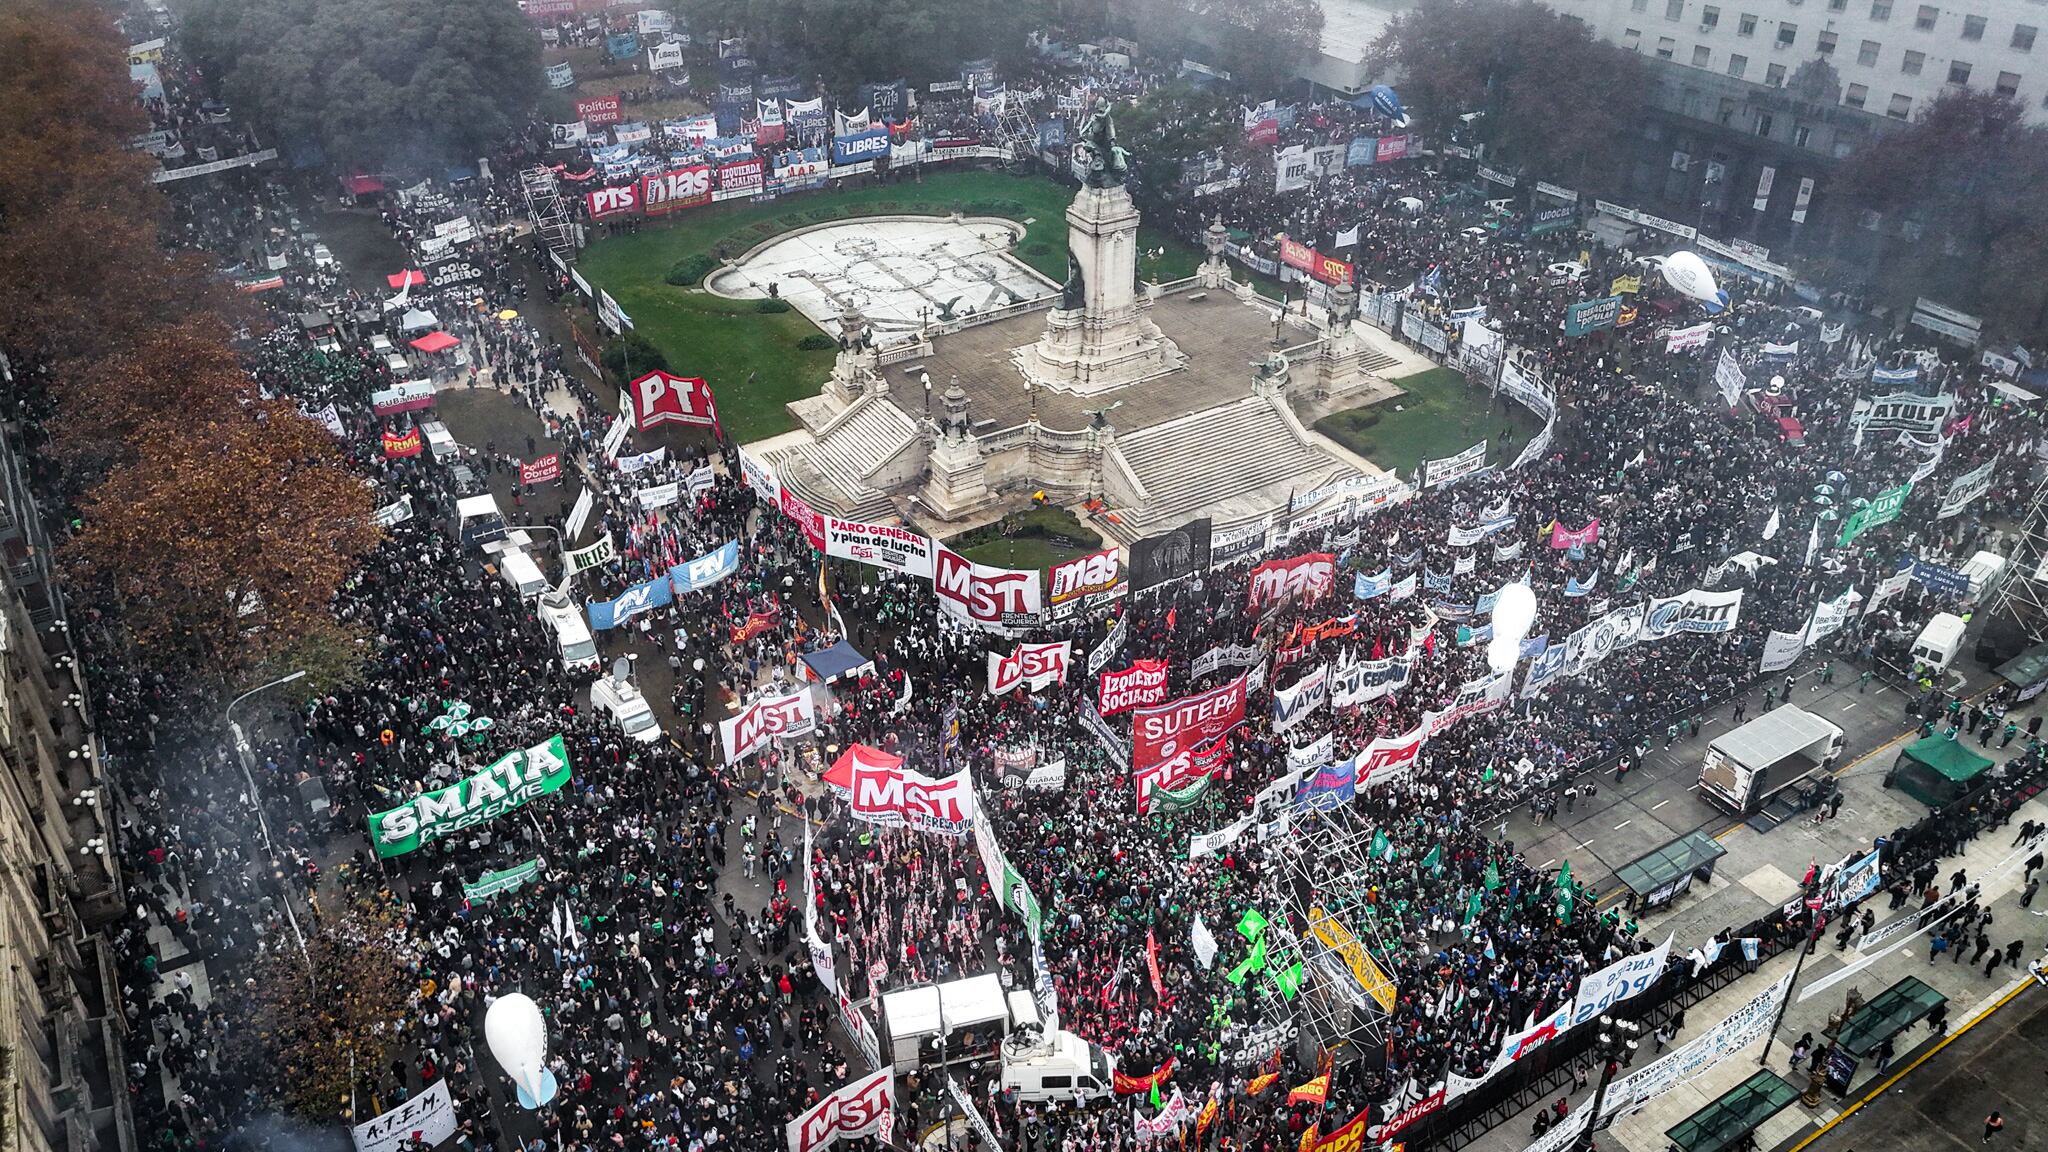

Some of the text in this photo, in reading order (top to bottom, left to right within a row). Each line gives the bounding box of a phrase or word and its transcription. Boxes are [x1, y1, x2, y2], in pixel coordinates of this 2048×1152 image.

[659, 50, 680, 59] LIBRES
[579, 100, 618, 113] Política
[846, 135, 888, 156] LIBRES
[721, 172, 763, 189] SOCIALISTA
[722, 162, 762, 177] IZQUIERDA
[1285, 164, 1307, 178] UTEP
[593, 185, 634, 212] PTS
[651, 169, 709, 203] mas
[433, 268, 482, 286] OBRERO
[438, 262, 471, 277] POLO
[1580, 310, 1614, 330] POPULAR
[1873, 403, 1947, 422] ATULP
[523, 465, 558, 480] Obrera
[831, 519, 925, 547] PARO GENERAL
[831, 531, 926, 558] y plan de lucha
[851, 545, 873, 558] MST
[1054, 570, 1063, 595] nuevo
[1062, 548, 1119, 593] mas
[939, 555, 1024, 620] MST
[1256, 561, 1336, 606] mas
[1001, 612, 1027, 622] FRENTE
[1001, 617, 1040, 627] IZQUIERDA
[1671, 620, 1730, 634] PRESENTE
[1001, 648, 1064, 683] MST
[740, 700, 801, 748] MST
[1144, 688, 1239, 740] SUTEPA
[380, 740, 564, 840] SMATA
[1028, 776, 1065, 785] TRABAJO
[858, 775, 958, 822] MST
[418, 780, 545, 847] PRESENTE
[366, 1092, 441, 1140] A.T.E.M.
[808, 1082, 882, 1147] MST
[1381, 1096, 1441, 1138] Política
